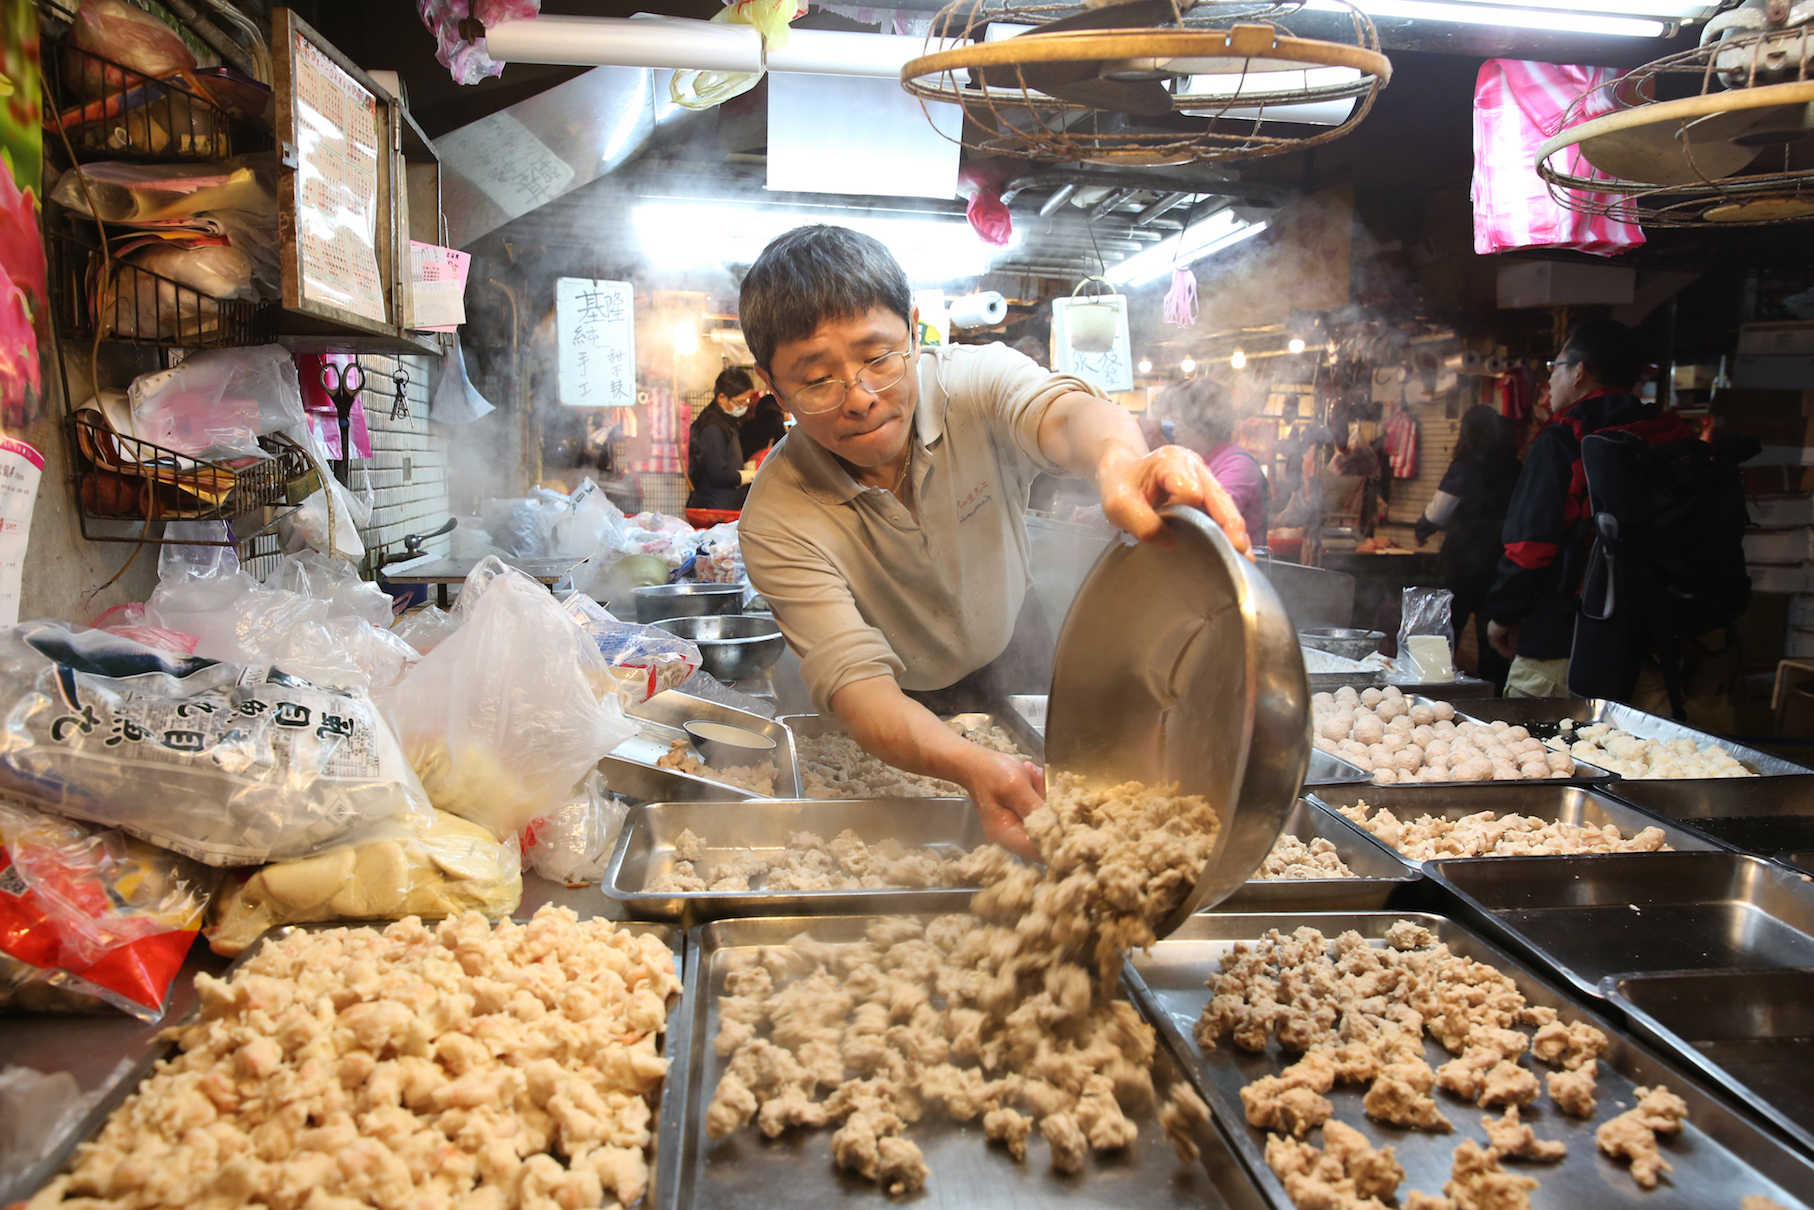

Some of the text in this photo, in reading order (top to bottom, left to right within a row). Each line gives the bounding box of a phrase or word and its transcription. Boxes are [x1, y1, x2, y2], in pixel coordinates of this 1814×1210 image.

[575, 288, 626, 324] 基隆
[572, 325, 610, 397] 純手工
